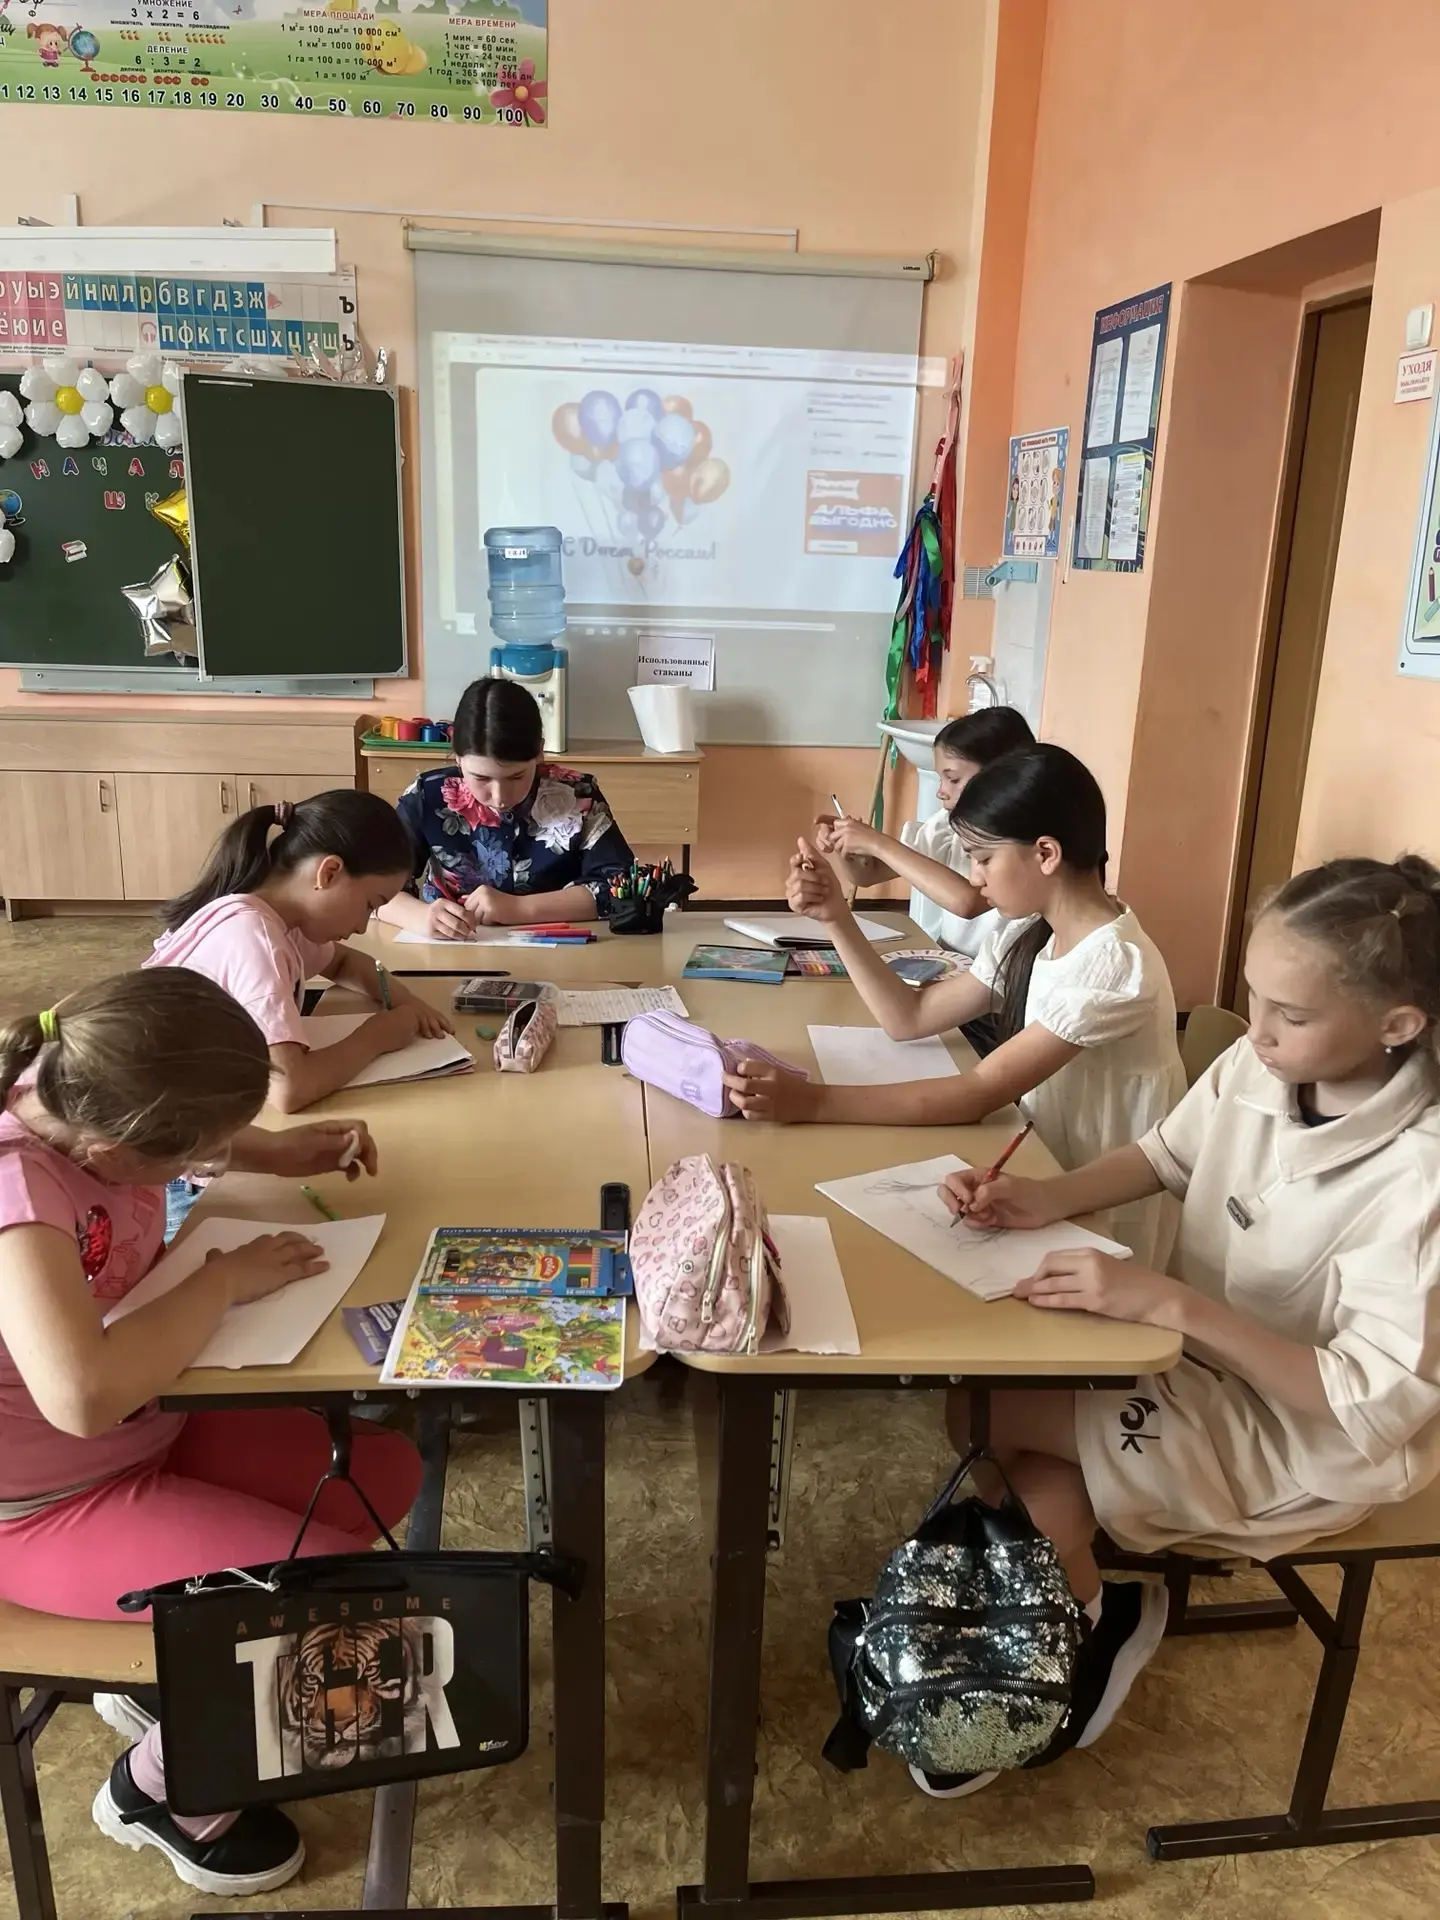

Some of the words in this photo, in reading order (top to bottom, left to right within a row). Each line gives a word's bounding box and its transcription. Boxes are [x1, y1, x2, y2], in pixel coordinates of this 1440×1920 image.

[137, 0, 193, 8] УМНОЖЕНИЕ
[131, 8, 137, 17] 3
[162, 10, 168, 19] 2
[193, 11, 199, 20] 6
[304, 10, 327, 18] МЕРА
[330, 11, 375, 20] ПЛОЩАДИ
[449, 18, 472, 26] МЕРА
[476, 19, 516, 28] ВРЕМЕНИ
[309, 25, 324, 33] 100
[353, 27, 362, 36] 10
[366, 28, 382, 36] 000
[486, 35, 496, 43] 60
[147, 45, 188, 54] ДЕЛЕНИЕ
[331, 42, 352, 50] 1000
[355, 43, 371, 51] 000
[318, 56, 333, 64] 100
[354, 58, 363, 66] 10
[367, 58, 383, 66] 000
[454, 52, 472, 60] сут.
[136, 56, 142, 65] 6
[164, 57, 169, 66] 3
[194, 58, 200, 67] 2
[451, 61, 484, 69] неделя
[502, 64, 520, 73] сут.
[341, 72, 356, 80] 100
[436, 68, 452, 76] год
[462, 69, 478, 77] 365
[482, 79, 496, 87] 100
[0, 85, 9, 98] 1
[16, 86, 35, 99] 12
[43, 87, 60, 99] 13
[69, 87, 87, 100] 14
[95, 88, 113, 101] 15
[122, 89, 140, 102] 16
[148, 90, 166, 103] 17
[174, 91, 191, 104] 18
[200, 92, 217, 105] 19
[226, 93, 245, 107] 20
[261, 95, 279, 108] 30
[295, 97, 313, 110] 40
[329, 98, 346, 112] 50
[363, 101, 381, 114] 60
[397, 103, 414, 116] 70
[431, 105, 448, 118] 80
[464, 106, 481, 120] 90
[496, 108, 522, 123] 100
[1100, 295, 1164, 334] ИНФОРМАЦИЯ
[1402, 360, 1432, 376] УХОДЯ
[814, 504, 893, 518] АЛЬФА
[808, 514, 898, 528] ВЫГОДНО
[638, 656, 709, 666] Использованные
[236, 1598, 452, 1636] AWESOME
[235, 1616, 460, 1781] TIGER
